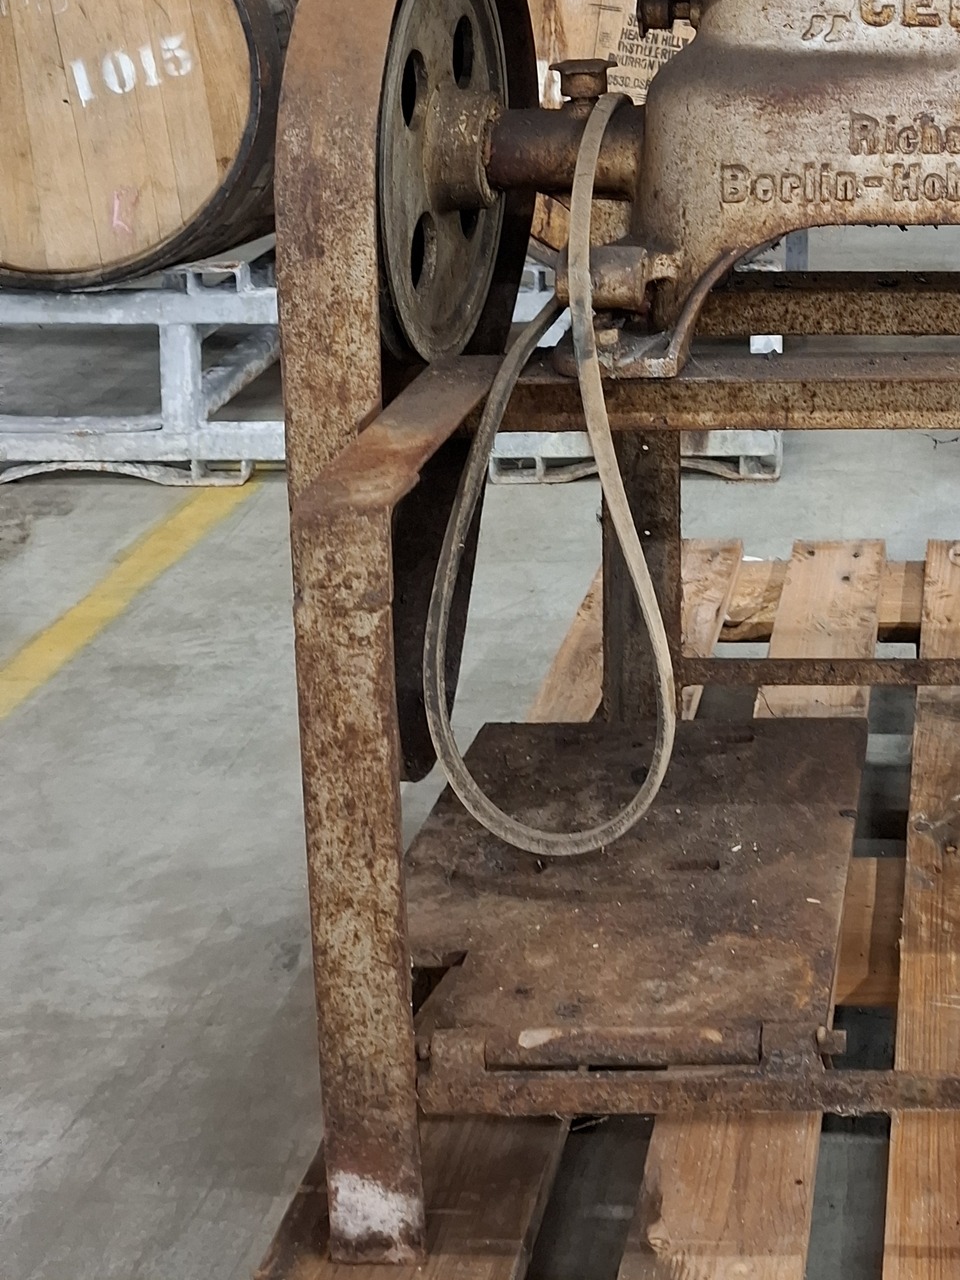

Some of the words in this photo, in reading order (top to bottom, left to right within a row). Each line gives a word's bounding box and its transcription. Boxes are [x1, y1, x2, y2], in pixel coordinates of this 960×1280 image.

[621, 27, 658, 45] HEAEN
[661, 34, 682, 48] HILL
[70, 32, 192, 107] 1015
